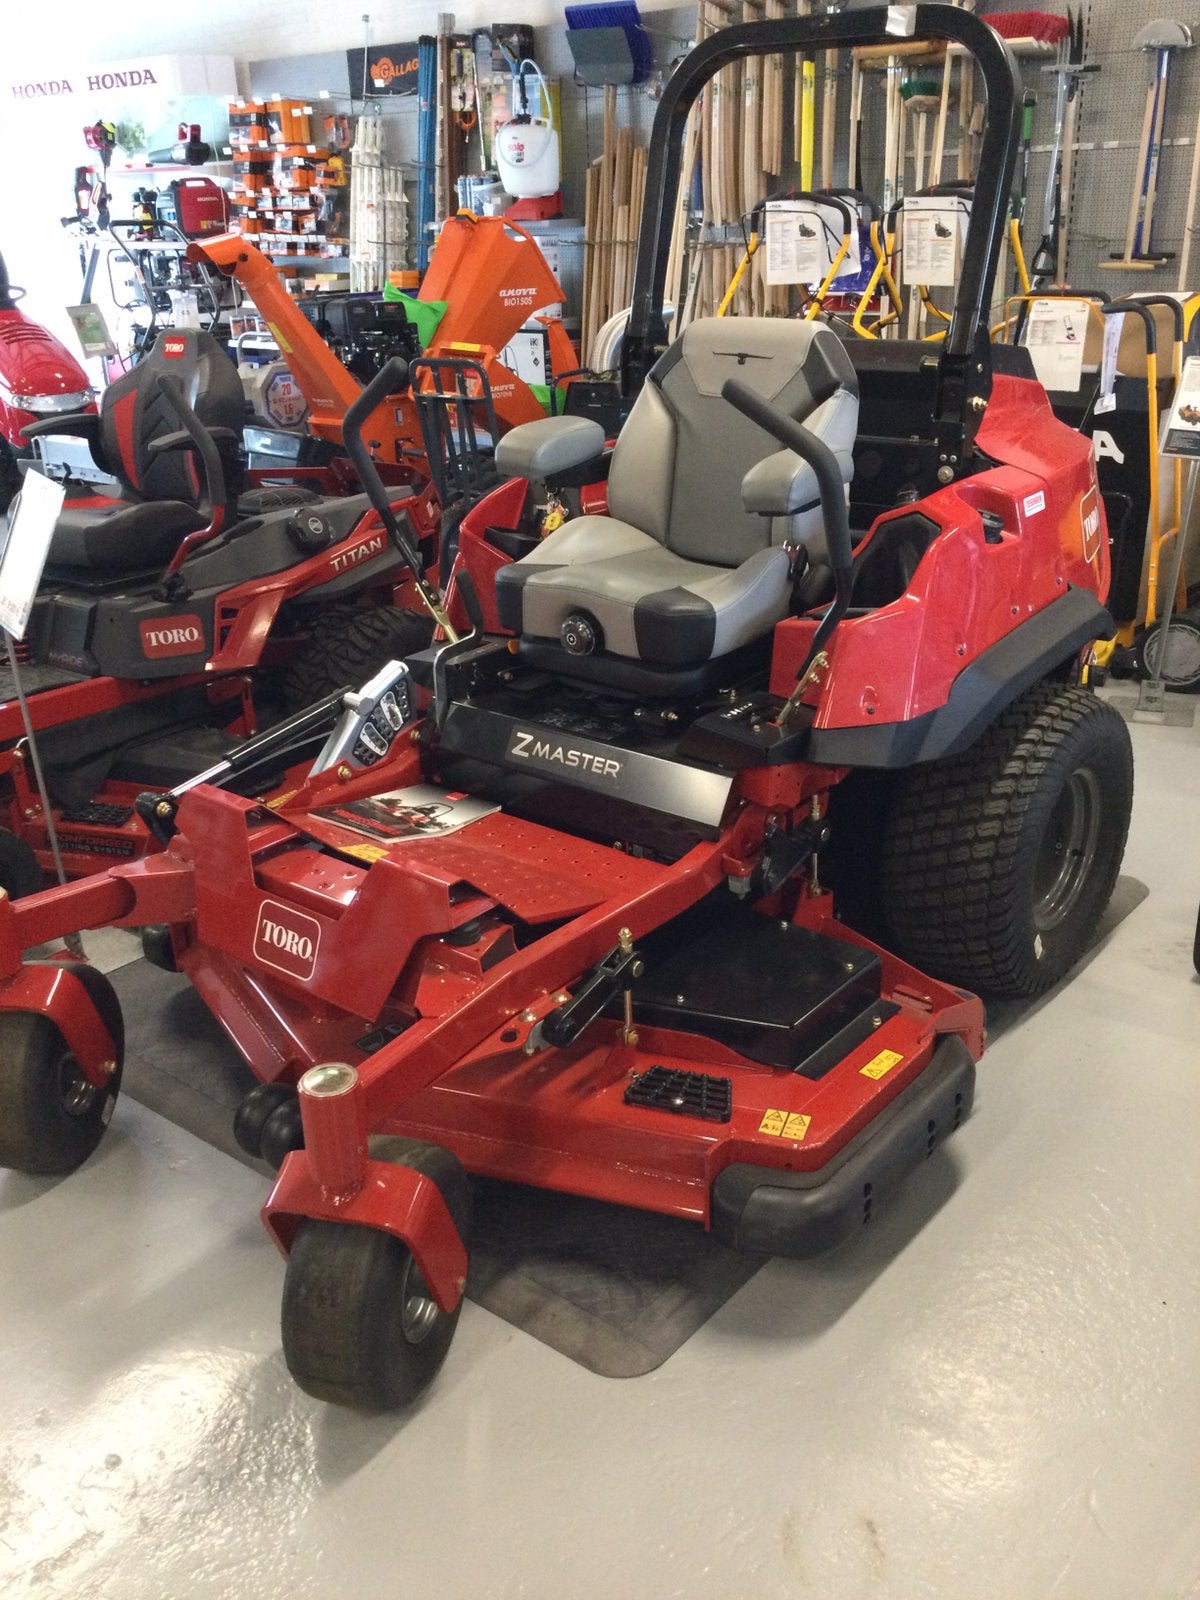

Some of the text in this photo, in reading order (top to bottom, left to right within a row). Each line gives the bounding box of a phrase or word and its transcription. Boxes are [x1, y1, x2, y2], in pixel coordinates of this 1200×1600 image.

[12, 79, 74, 100] HONDA
[87, 68, 158, 91] HONDA
[499, 287, 538, 297] anova
[164, 342, 185, 353] TORO
[330, 536, 383, 572] TITAN
[145, 626, 200, 647] TORO
[262, 918, 313, 960] TORO
